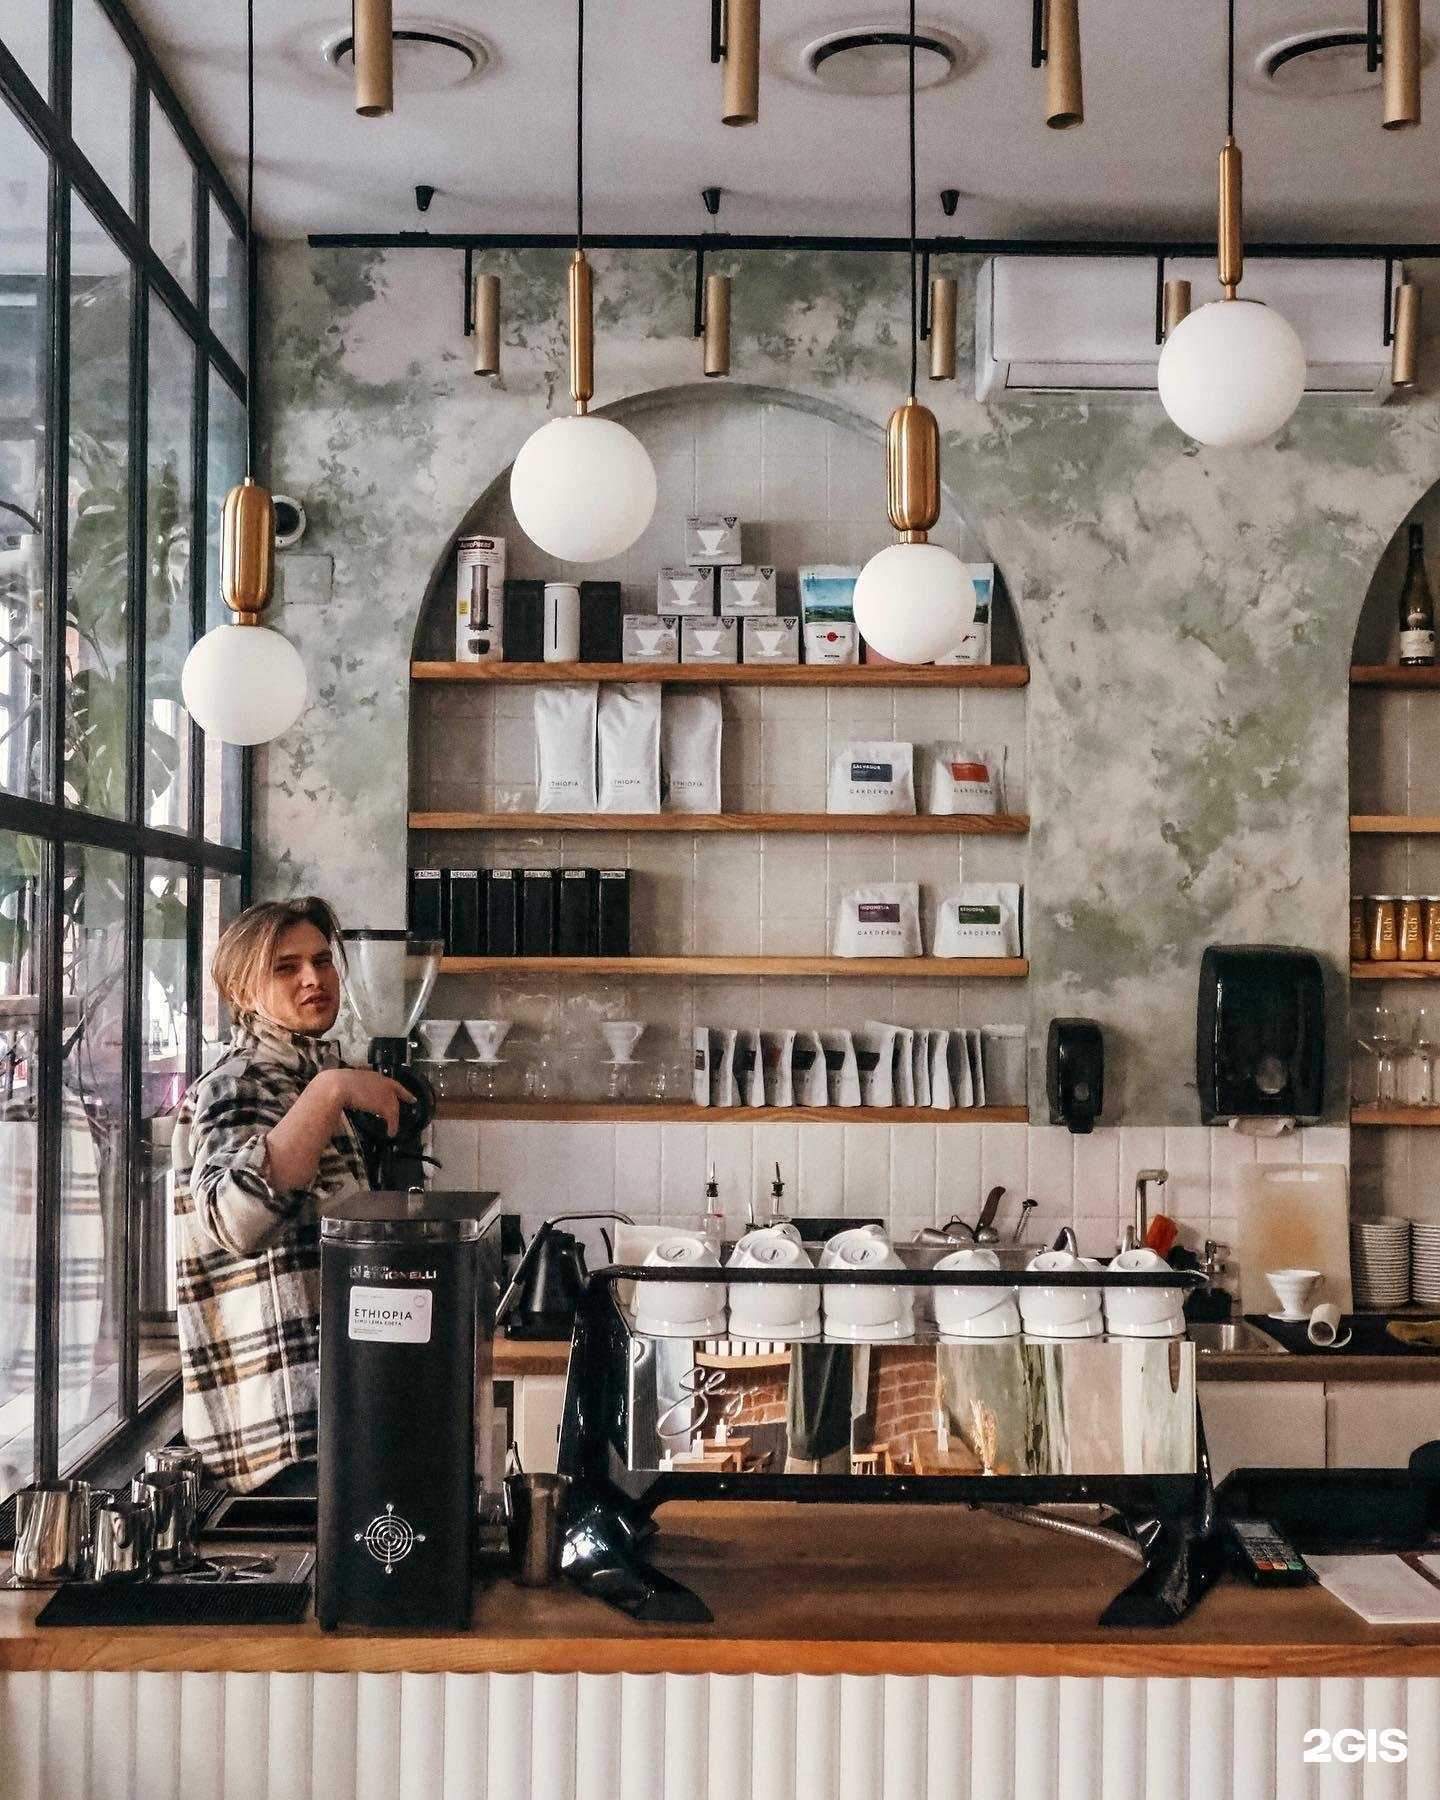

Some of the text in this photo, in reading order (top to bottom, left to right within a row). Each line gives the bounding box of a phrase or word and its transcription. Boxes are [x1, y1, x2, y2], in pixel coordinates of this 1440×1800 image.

[1383, 917, 1393, 941] Rich
[1408, 917, 1418, 941] Rich
[354, 1308, 413, 1320] ETHIOPIA
